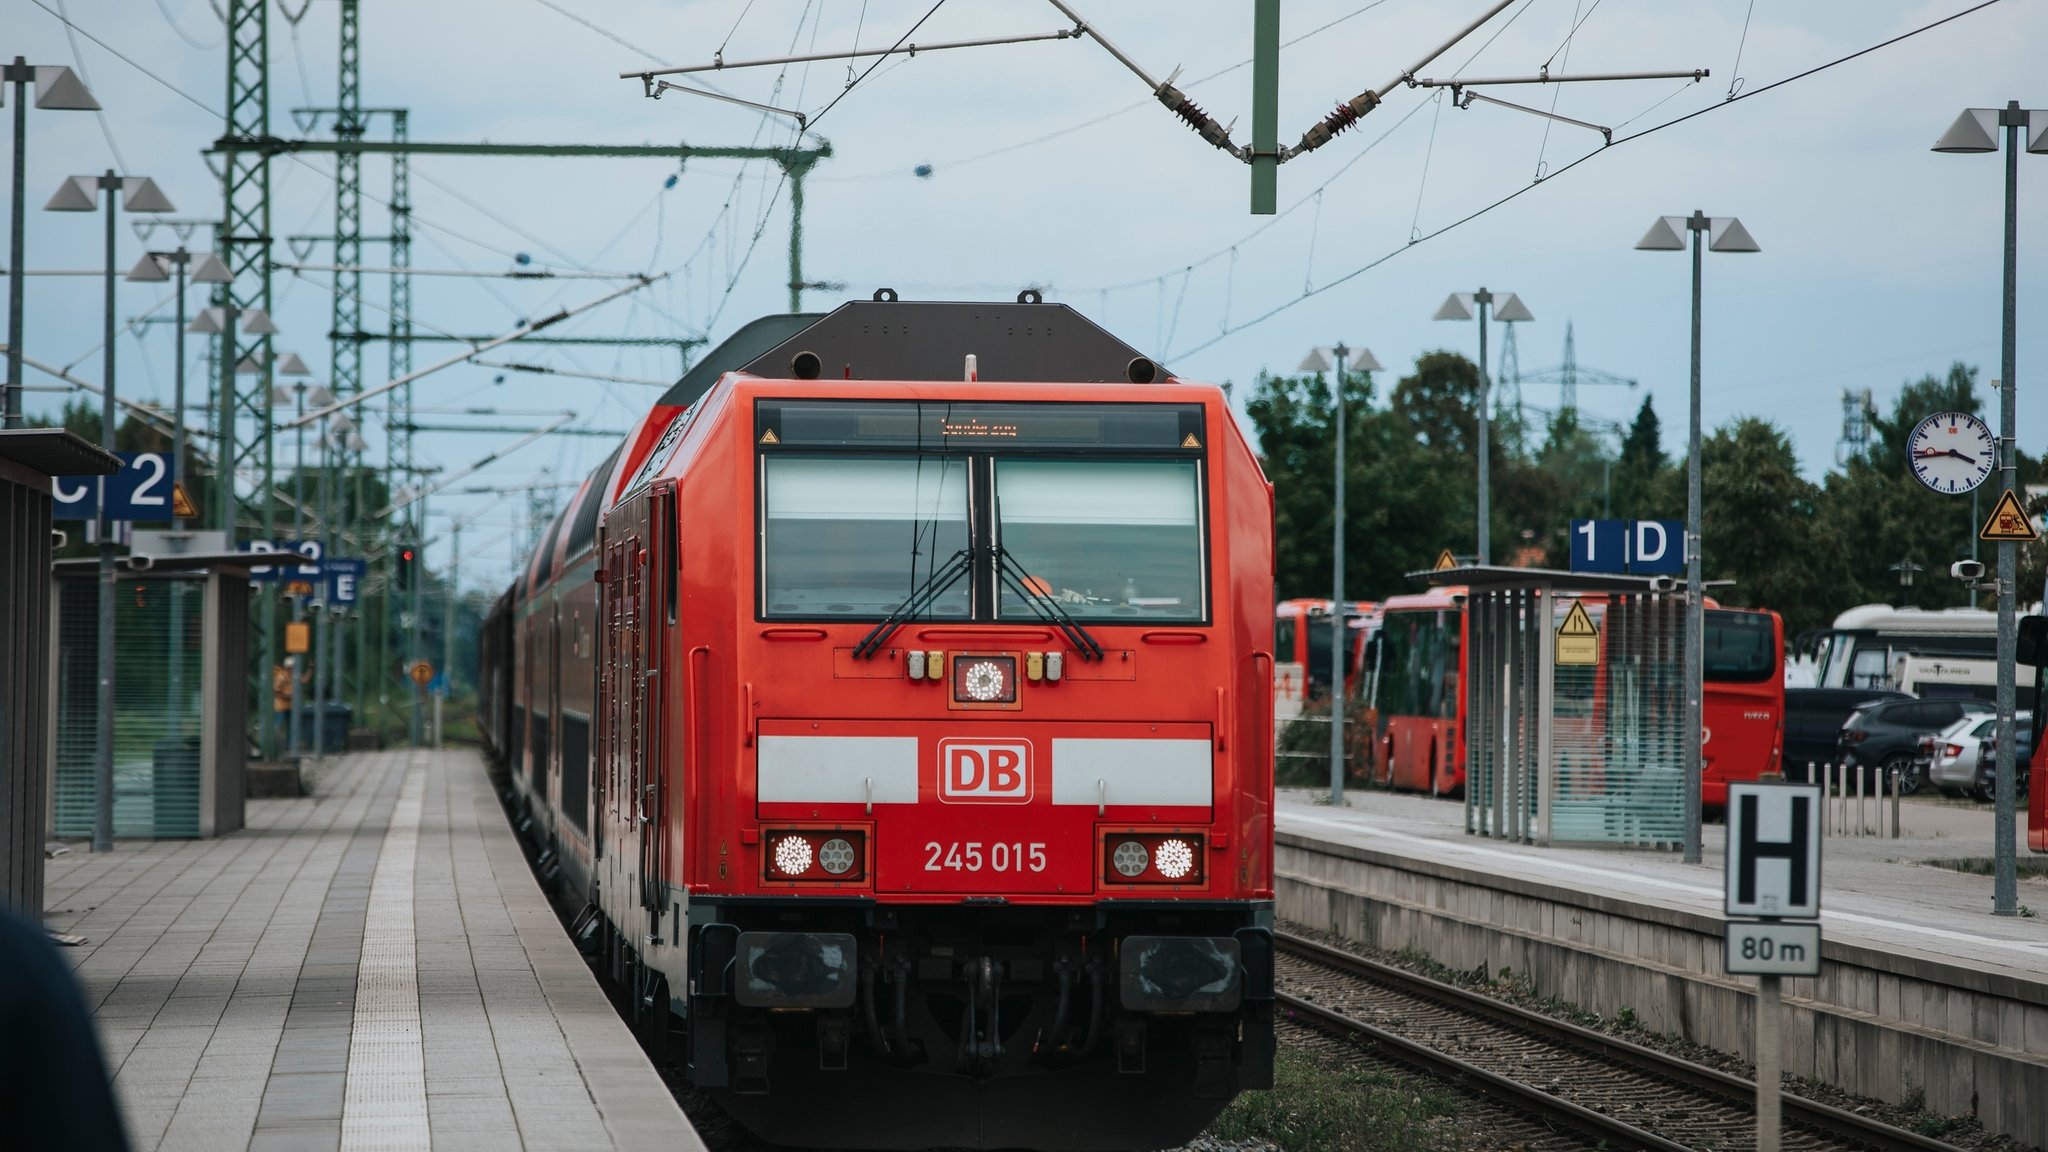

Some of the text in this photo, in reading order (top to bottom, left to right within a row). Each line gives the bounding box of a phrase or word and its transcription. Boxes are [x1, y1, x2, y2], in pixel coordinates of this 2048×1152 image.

[130, 453, 166, 506] 2
[298, 541, 321, 575] 2
[1578, 520, 1667, 562] 1 D
[337, 574, 355, 601] E
[951, 749, 1021, 791] DB
[924, 841, 1046, 872] 245 015
[1738, 794, 1810, 906] H
[1741, 936, 1805, 962] 80 m
